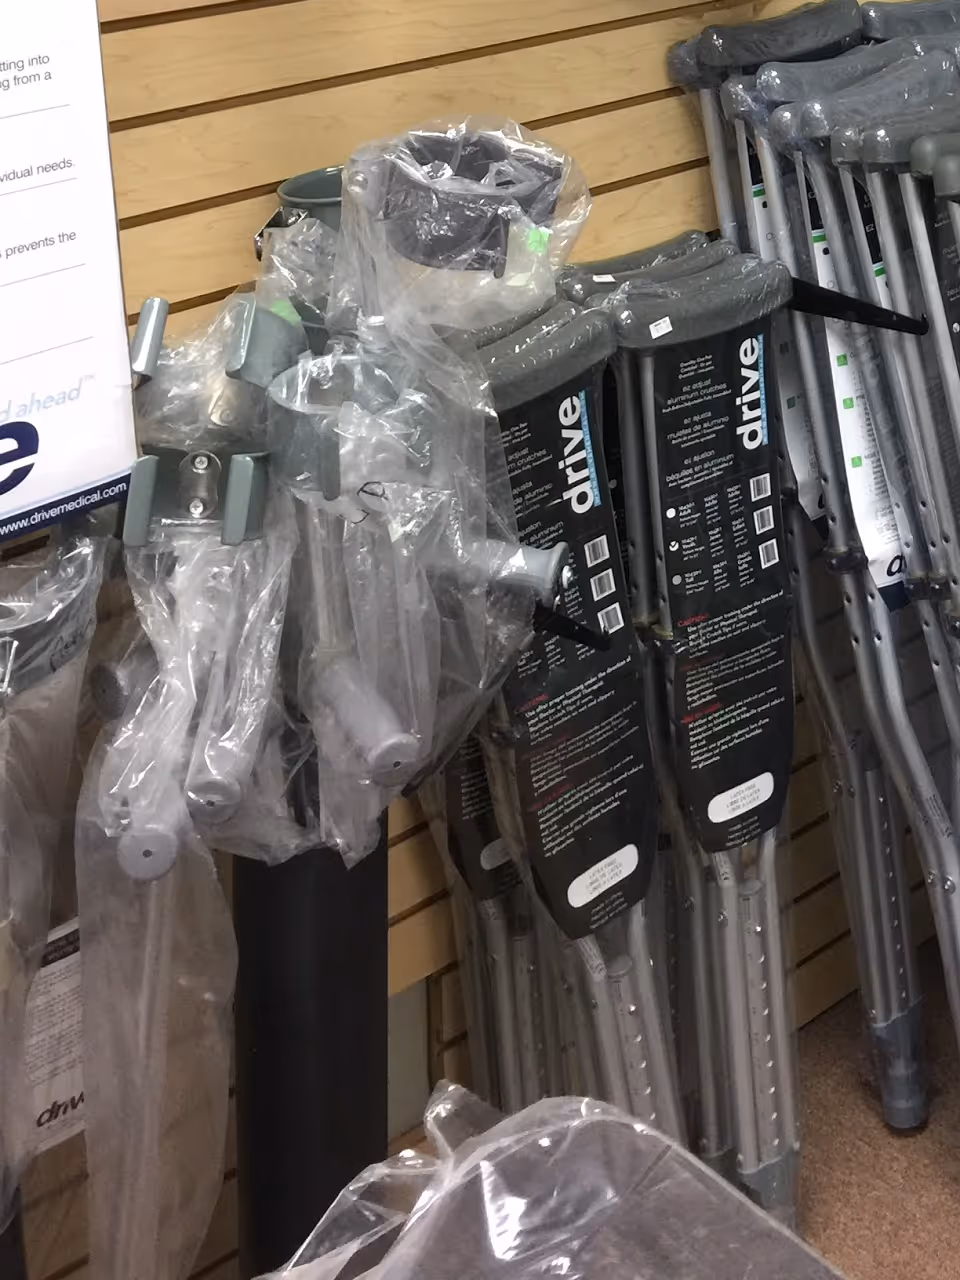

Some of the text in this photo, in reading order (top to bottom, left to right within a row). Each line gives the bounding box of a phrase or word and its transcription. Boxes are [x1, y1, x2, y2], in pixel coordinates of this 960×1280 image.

[28, 54, 50, 67] into
[13, 73, 40, 86] from
[44, 71, 52, 80] a
[36, 157, 76, 176] needs.
[5, 230, 77, 259] prevents the
[736, 337, 763, 450] drive
[559, 396, 594, 514] drive
[0, 481, 127, 535] www.drivemedical.com
[36, 1091, 84, 1128] driv
